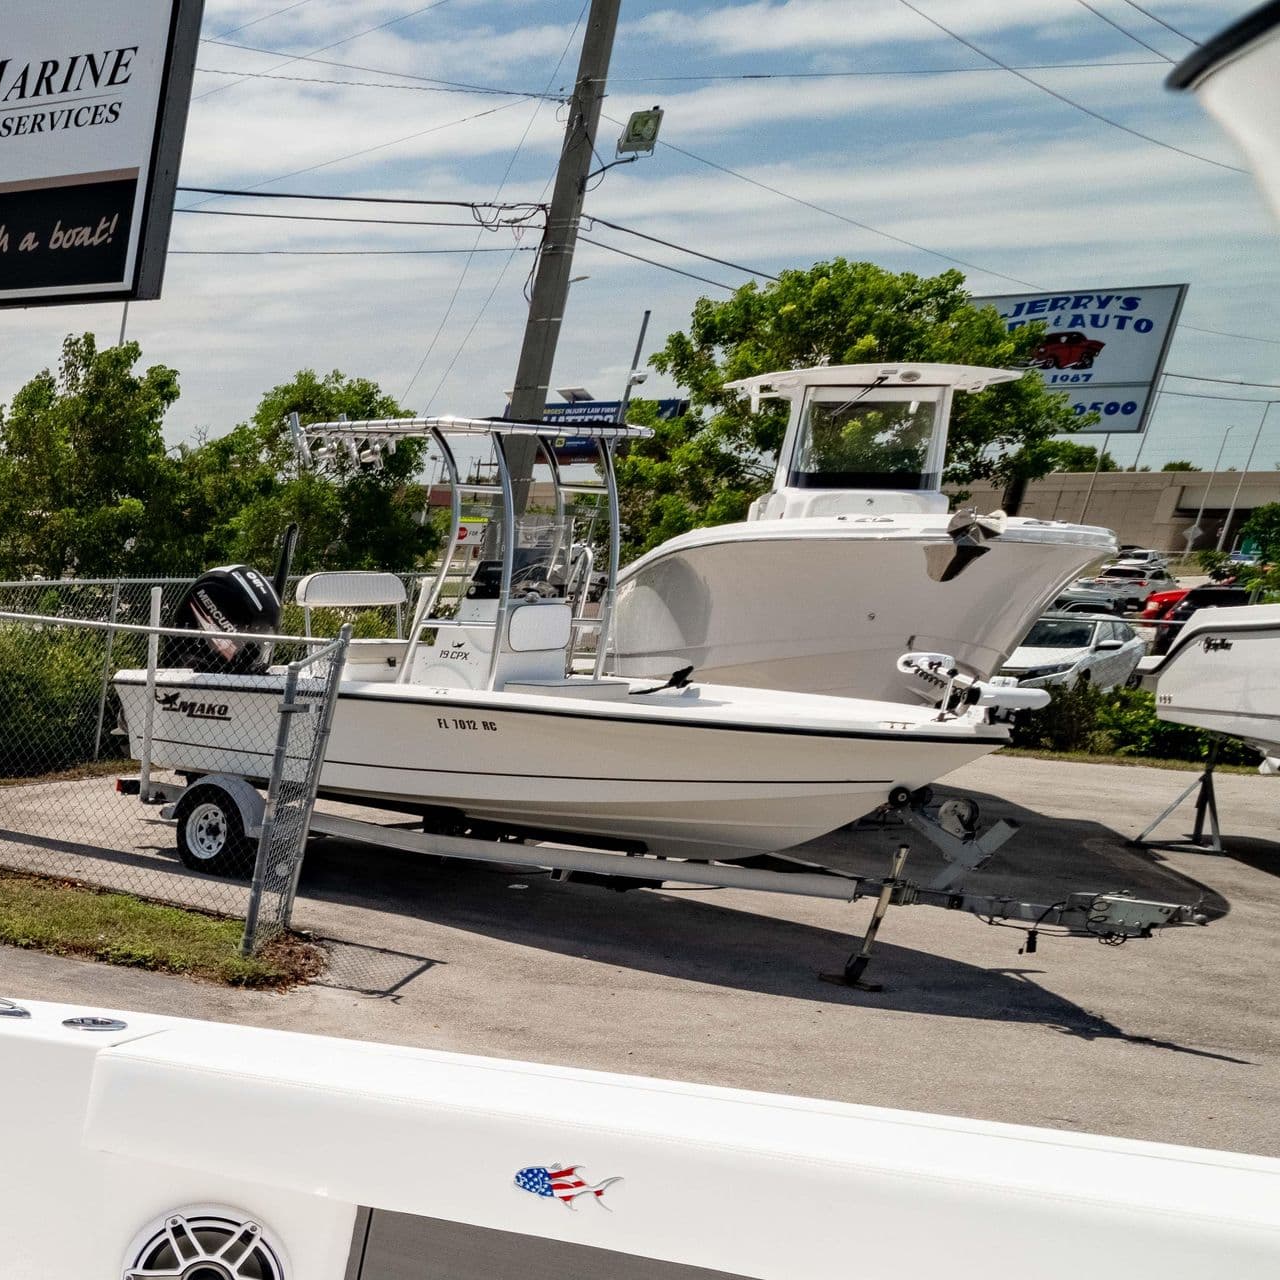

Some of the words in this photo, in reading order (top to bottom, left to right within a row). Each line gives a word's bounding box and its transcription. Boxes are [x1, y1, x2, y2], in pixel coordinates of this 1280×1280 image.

[23, 230, 39, 251] a
[49, 213, 119, 250] boat!
[1001, 294, 1142, 319] JERRY'S
[1067, 313, 1154, 334] AUTO
[450, 651, 470, 660] CPX
[177, 700, 230, 716] MAKO
[437, 718, 449, 729] FL
[452, 719, 478, 730] 7012
[482, 721, 497, 731] RC
